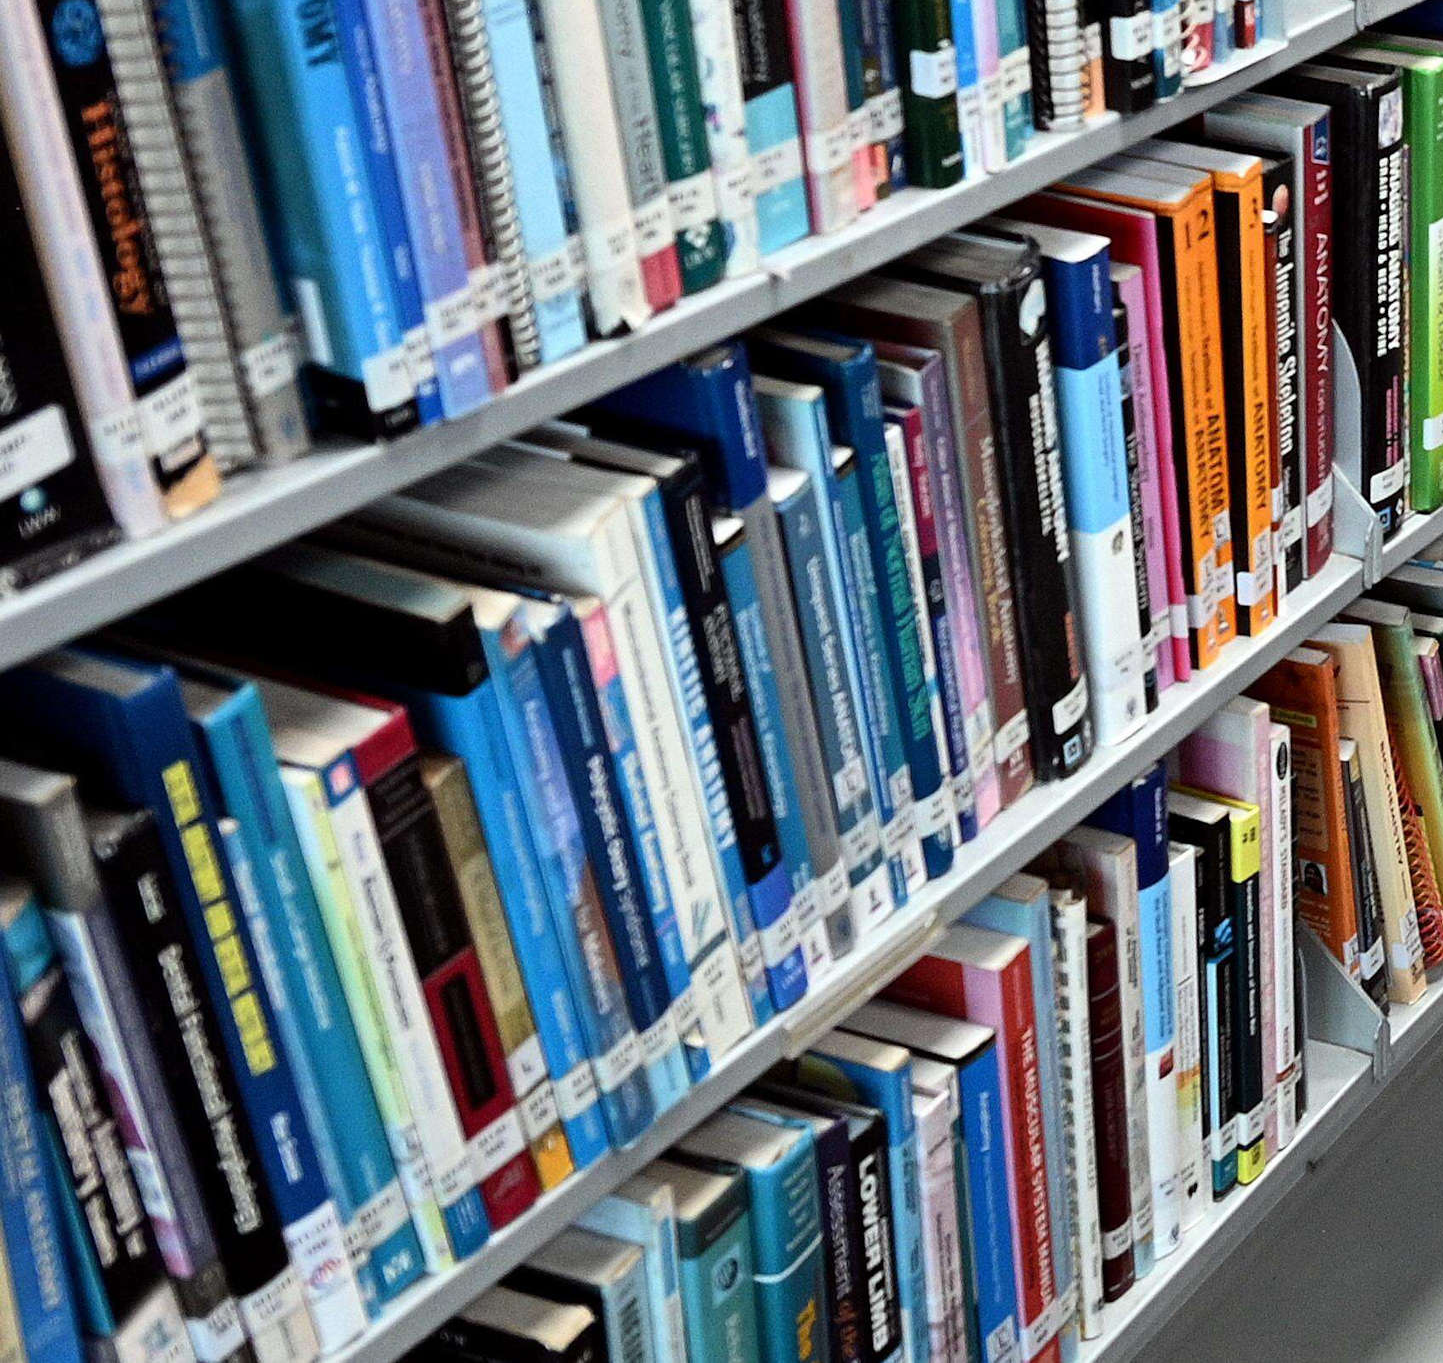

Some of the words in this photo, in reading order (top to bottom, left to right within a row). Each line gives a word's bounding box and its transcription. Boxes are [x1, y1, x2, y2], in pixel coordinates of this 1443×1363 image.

[81, 100, 155, 314] Histology
[1378, 158, 1388, 200] BRAIN
[1388, 151, 1401, 247] IMAGING
[1278, 228, 1292, 258] The
[1378, 214, 1388, 251] HEAD
[1275, 261, 1296, 354] Juvenile
[1316, 232, 1330, 374] ANATOMY
[1377, 267, 1388, 304] NECK
[1387, 250, 1401, 350] ANATOMY
[1377, 318, 1387, 358] SPINE
[1277, 355, 1297, 457] Skeleton
[1193, 427, 1211, 540] ANATOMY
[1252, 399, 1268, 511] ANATOMY
[672, 606, 709, 719] KINETIC
[692, 723, 734, 849] ANATOMY
[589, 755, 618, 838] Polycystic
[606, 837, 630, 891] Ovary
[1280, 784, 1289, 843] MILADY'S
[1280, 848, 1289, 911] STANDARD
[1021, 1028, 1035, 1065] THE
[1022, 1067, 1044, 1169] MUSCULAR
[828, 1164, 852, 1298] Assessment
[859, 1154, 882, 1270] LOWER
[1030, 1170, 1048, 1241] SYSTEM
[867, 1271, 889, 1353] LIMB
